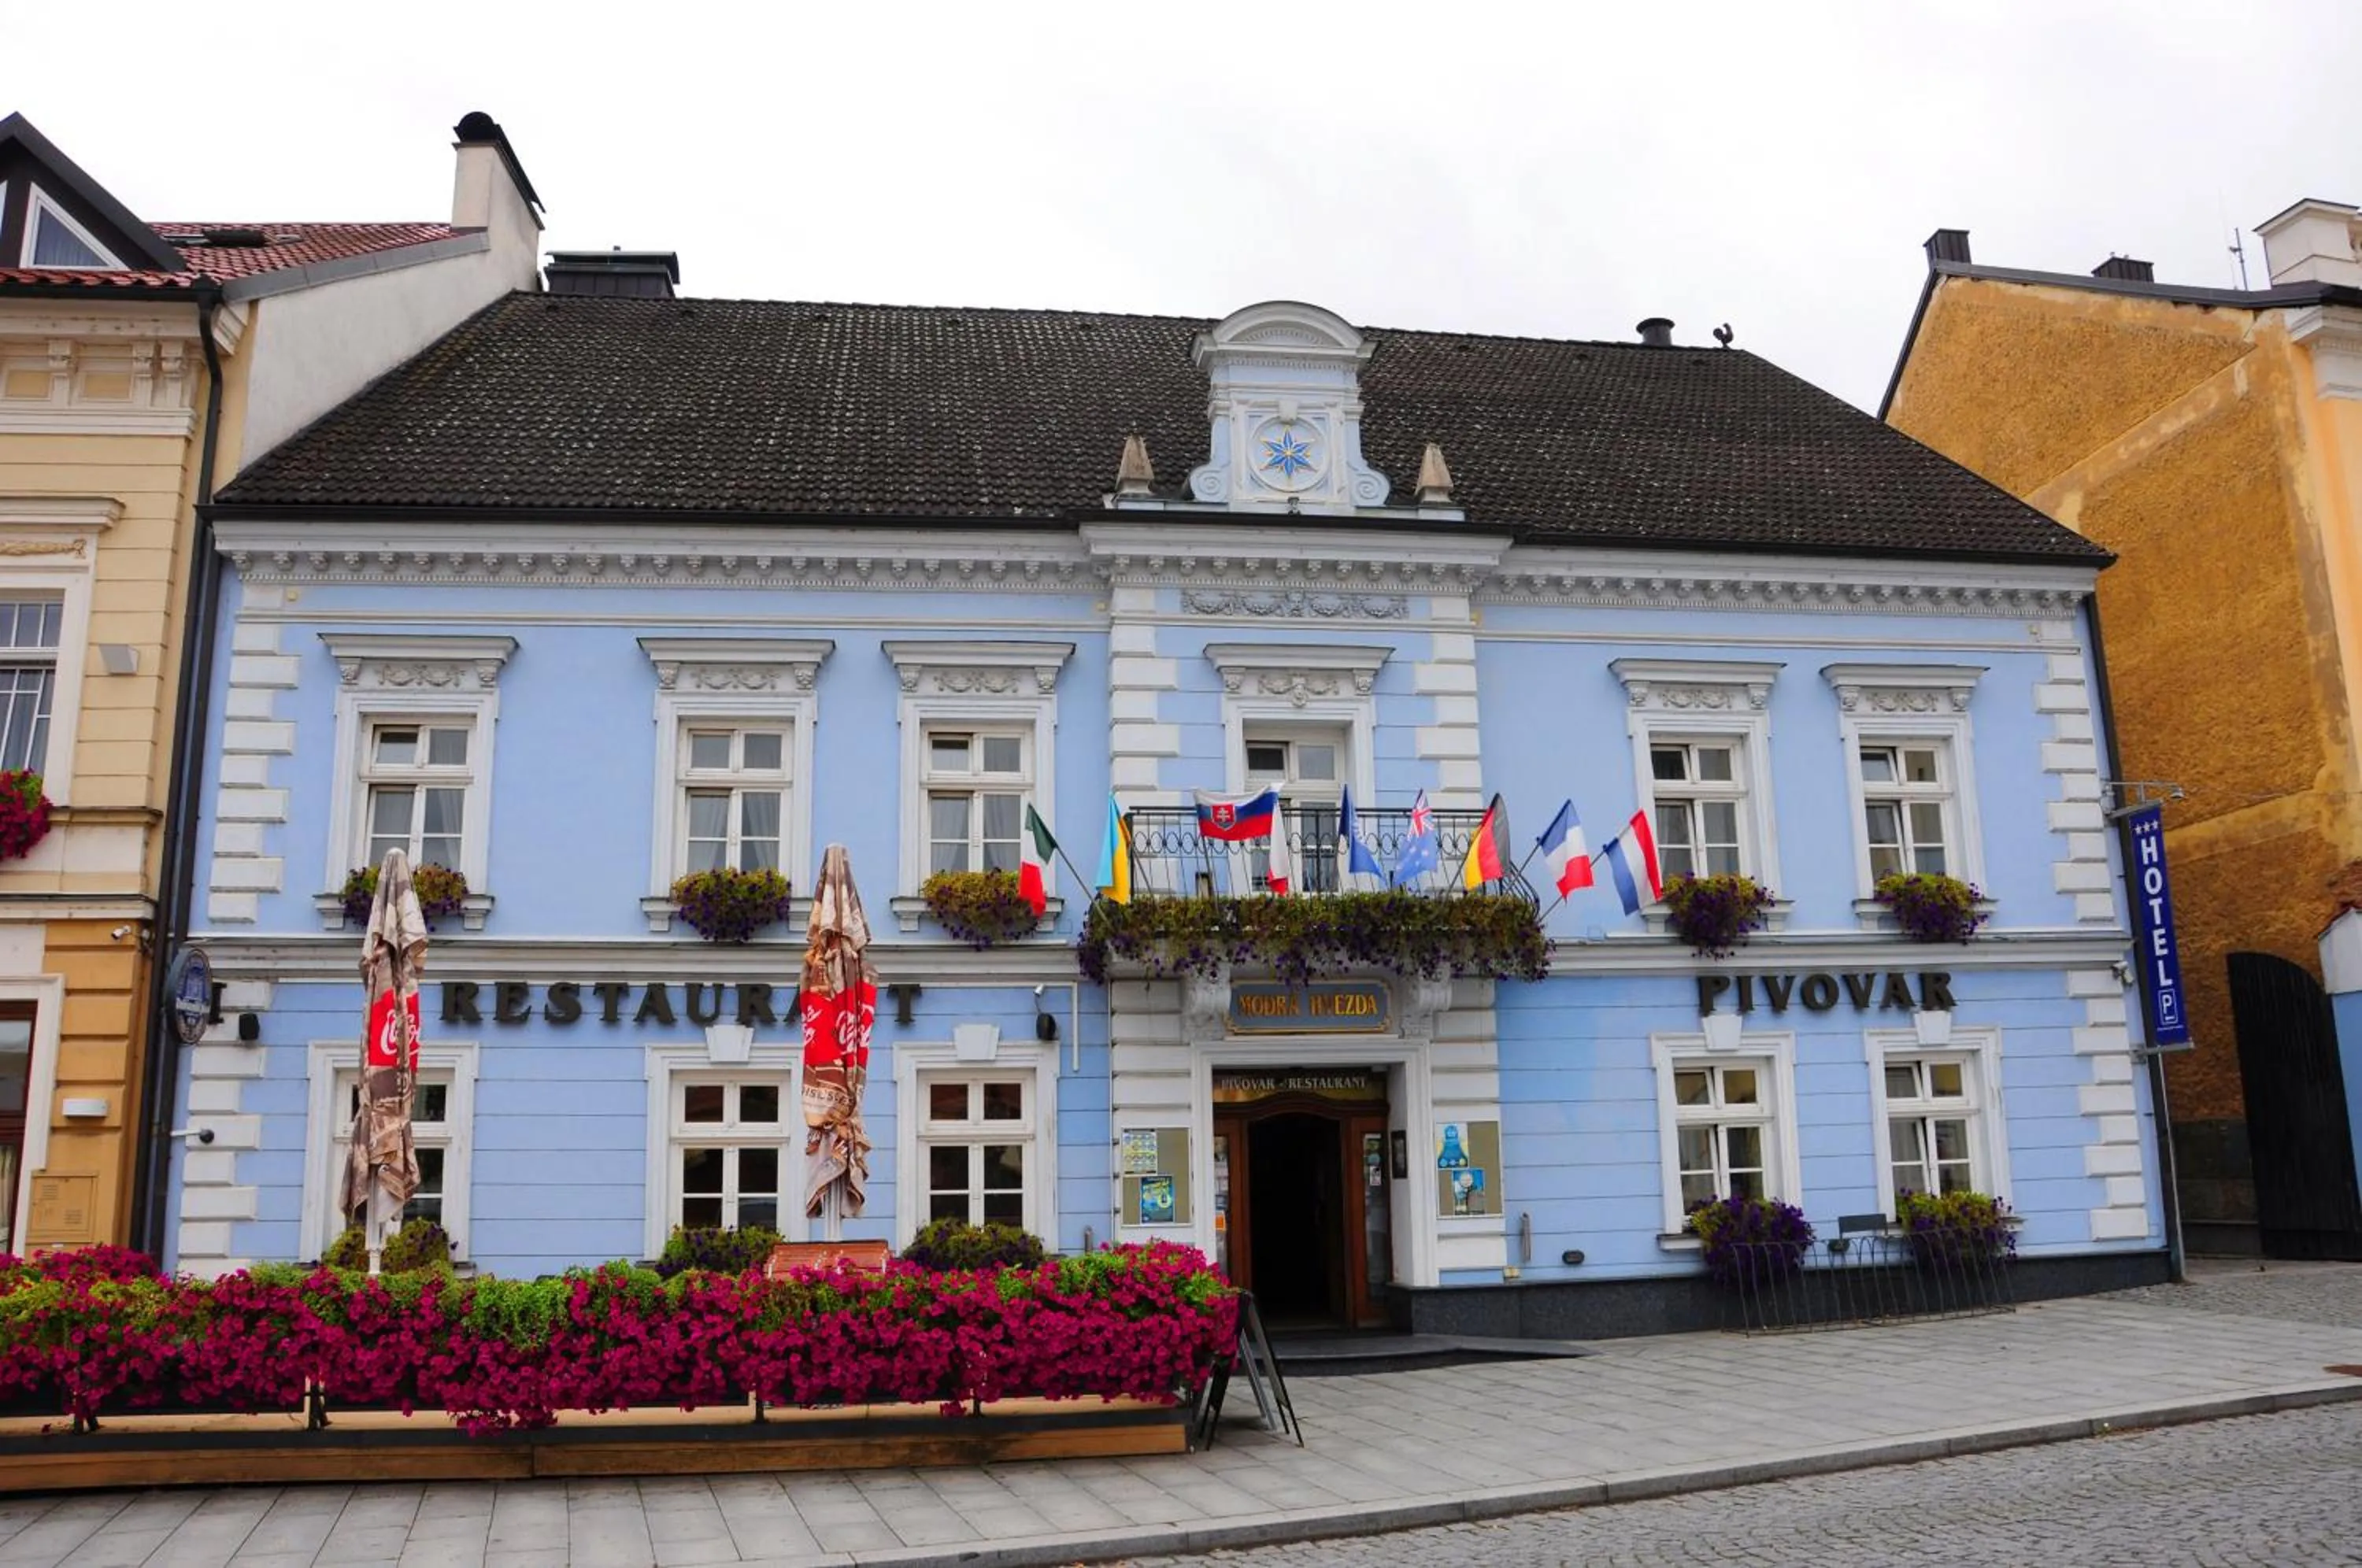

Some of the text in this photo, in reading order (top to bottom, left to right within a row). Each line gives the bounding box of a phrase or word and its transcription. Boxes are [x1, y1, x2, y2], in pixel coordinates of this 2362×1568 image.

[2140, 836, 2173, 987] HOTEL
[439, 981, 922, 1023] RESTAURT
[1697, 972, 1957, 1017] PIVOVAR
